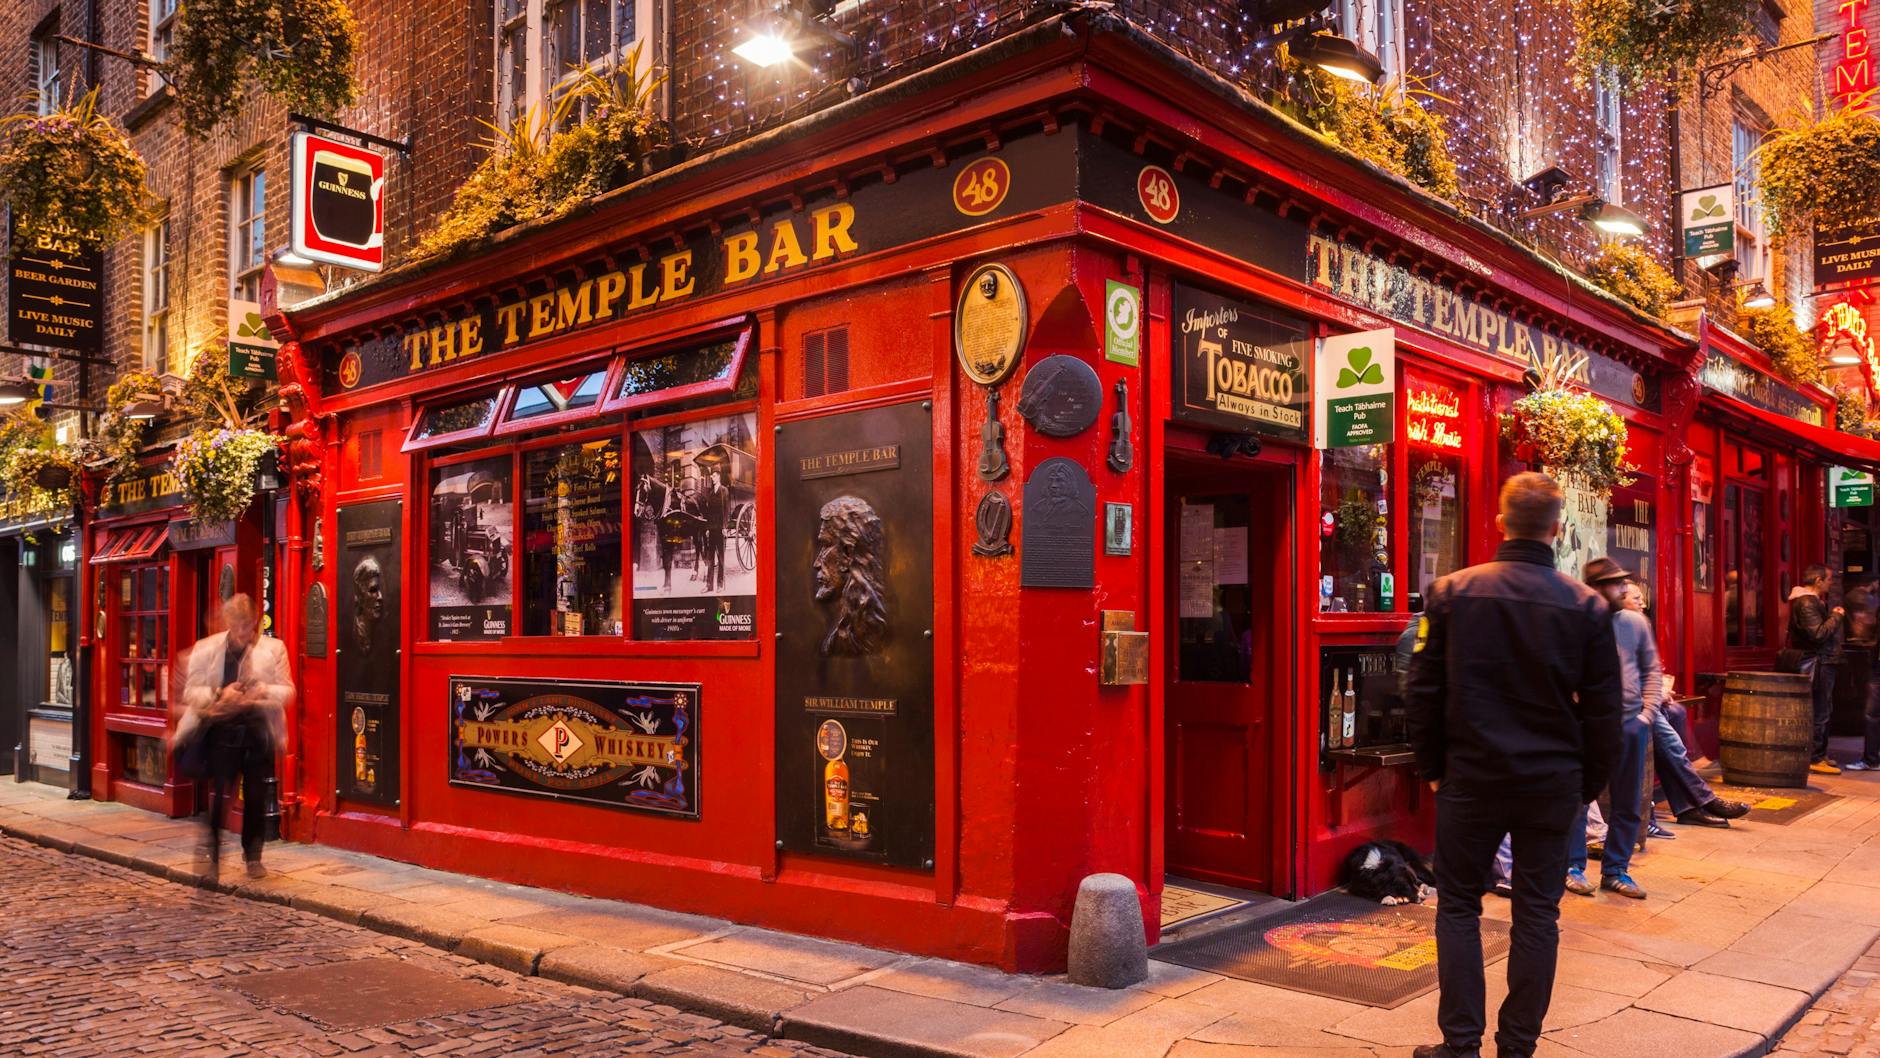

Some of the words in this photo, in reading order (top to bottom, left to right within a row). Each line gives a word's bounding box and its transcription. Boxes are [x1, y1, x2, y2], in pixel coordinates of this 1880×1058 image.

[1836, 0, 1872, 112] TEMP
[318, 180, 366, 200] GUINNESS
[962, 168, 999, 206] 48
[1144, 173, 1171, 210] 48
[1821, 254, 1849, 265] LIVE
[1850, 248, 1880, 260] MUSI
[1837, 260, 1873, 273] DAILY
[15, 269, 47, 283] BEER
[48, 275, 97, 290] GARDEN
[404, 315, 484, 371] THE
[497, 249, 697, 345] TEMPLE
[723, 202, 858, 285] BAR
[1308, 233, 1398, 312] THE
[1412, 278, 1531, 362] TEMPLE
[18, 309, 49, 322] LIVE
[52, 314, 94, 328] MUSIC
[1182, 307, 1238, 339] Importers
[36, 324, 76, 338] DAILY
[1218, 328, 1228, 339] OF
[1232, 340, 1252, 357] FINE
[1254, 346, 1292, 367] SMOKING
[344, 361, 356, 383] 48
[1197, 339, 1293, 405] TOBACCO
[1218, 395, 1255, 414] Always
[1260, 407, 1269, 417] in
[1272, 407, 1299, 424] Stock
[1335, 404, 1353, 412] Teach
[1354, 412, 1366, 420] Pub
[801, 457, 821, 470] THE
[825, 449, 870, 467] TEMPLE
[873, 446, 896, 460] BAR
[117, 480, 146, 503] THE
[1577, 492, 1598, 517] BAR
[483, 619, 506, 629] GUINNESS
[720, 613, 752, 625] GUINNESS
[804, 697, 818, 708] SIR
[819, 697, 857, 709] WILLIAM
[859, 700, 895, 710] TEMPLE
[477, 726, 528, 746] POWERS
[553, 727, 570, 757] P
[594, 734, 666, 759] WHISKEY
